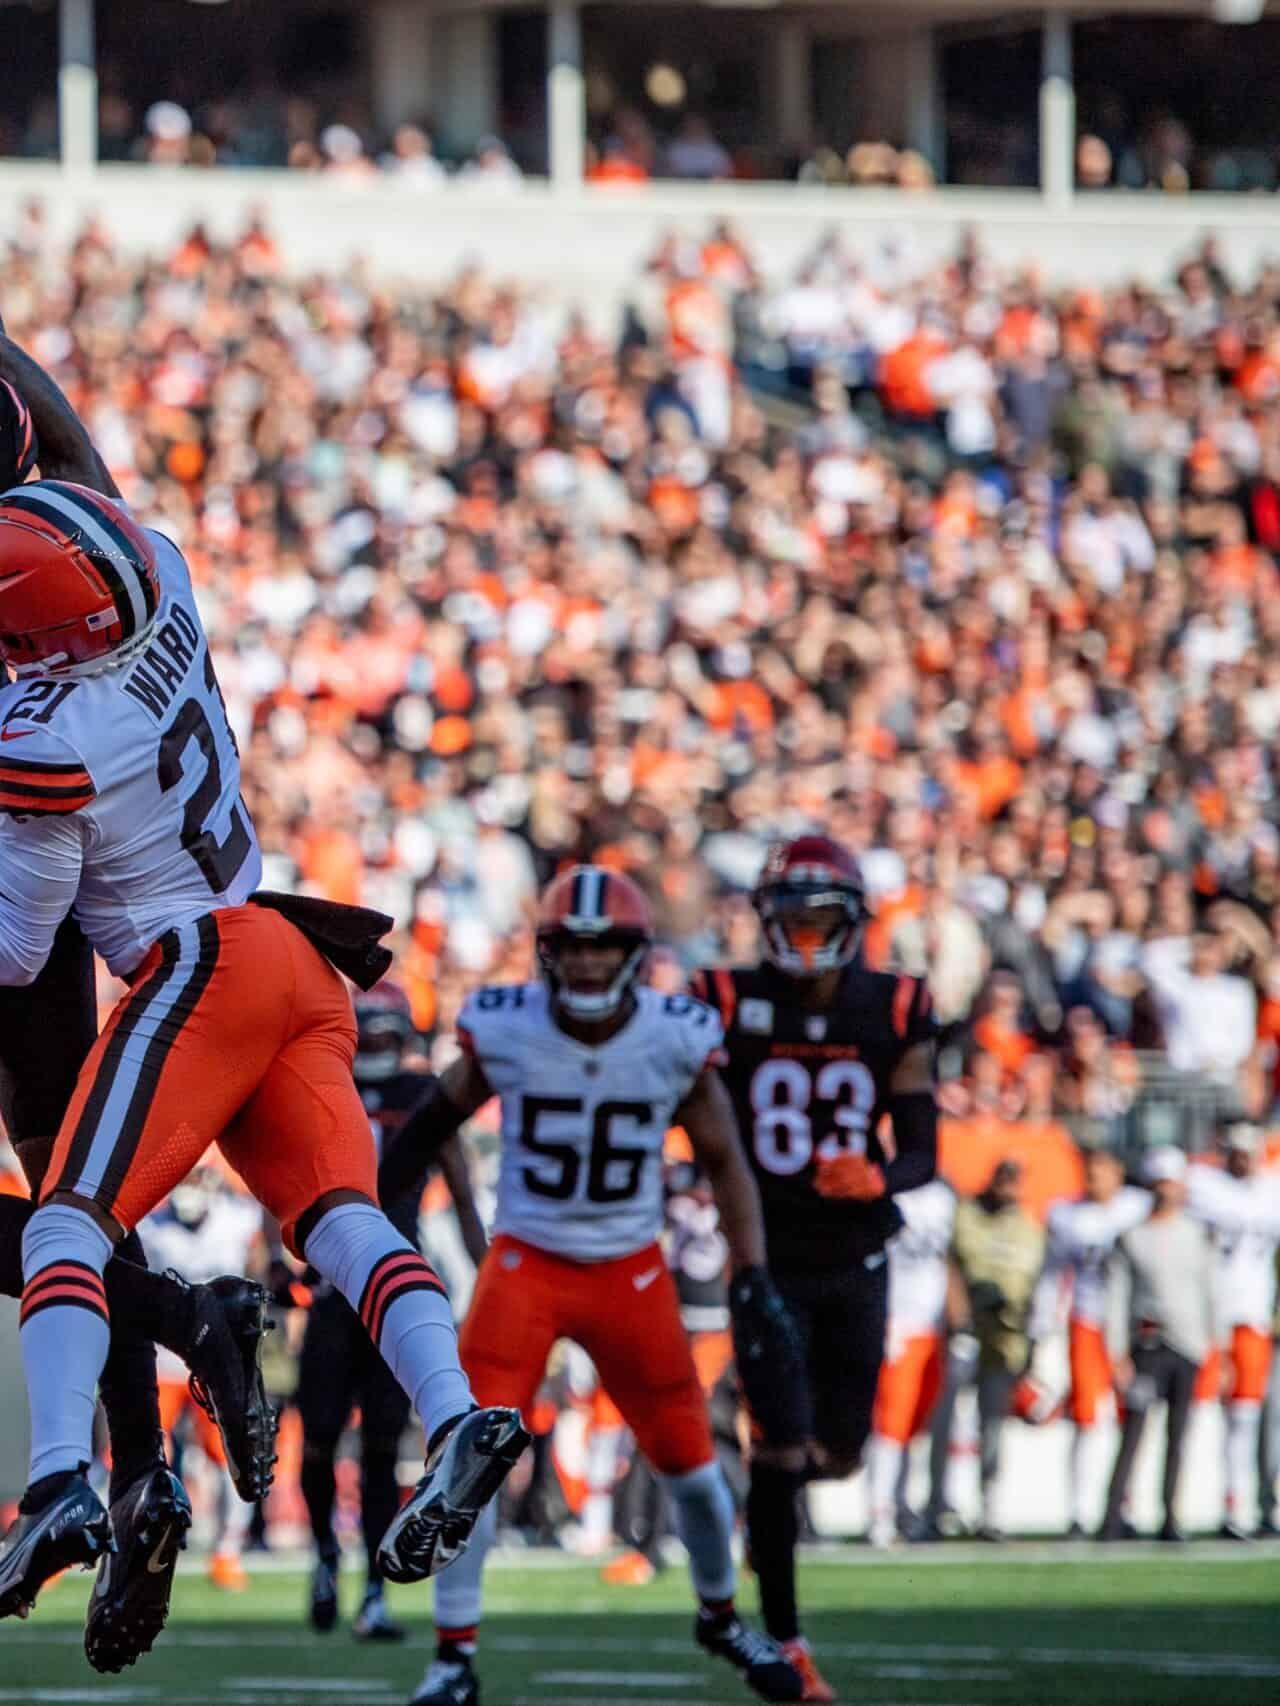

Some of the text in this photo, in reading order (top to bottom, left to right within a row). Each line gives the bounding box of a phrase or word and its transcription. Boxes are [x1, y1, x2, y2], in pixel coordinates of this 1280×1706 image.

[2, 680, 79, 726] 21
[124, 602, 199, 721] WARD
[157, 648, 253, 895] 2
[521, 1094, 653, 1204] 56
[750, 1058, 876, 1175] 83
